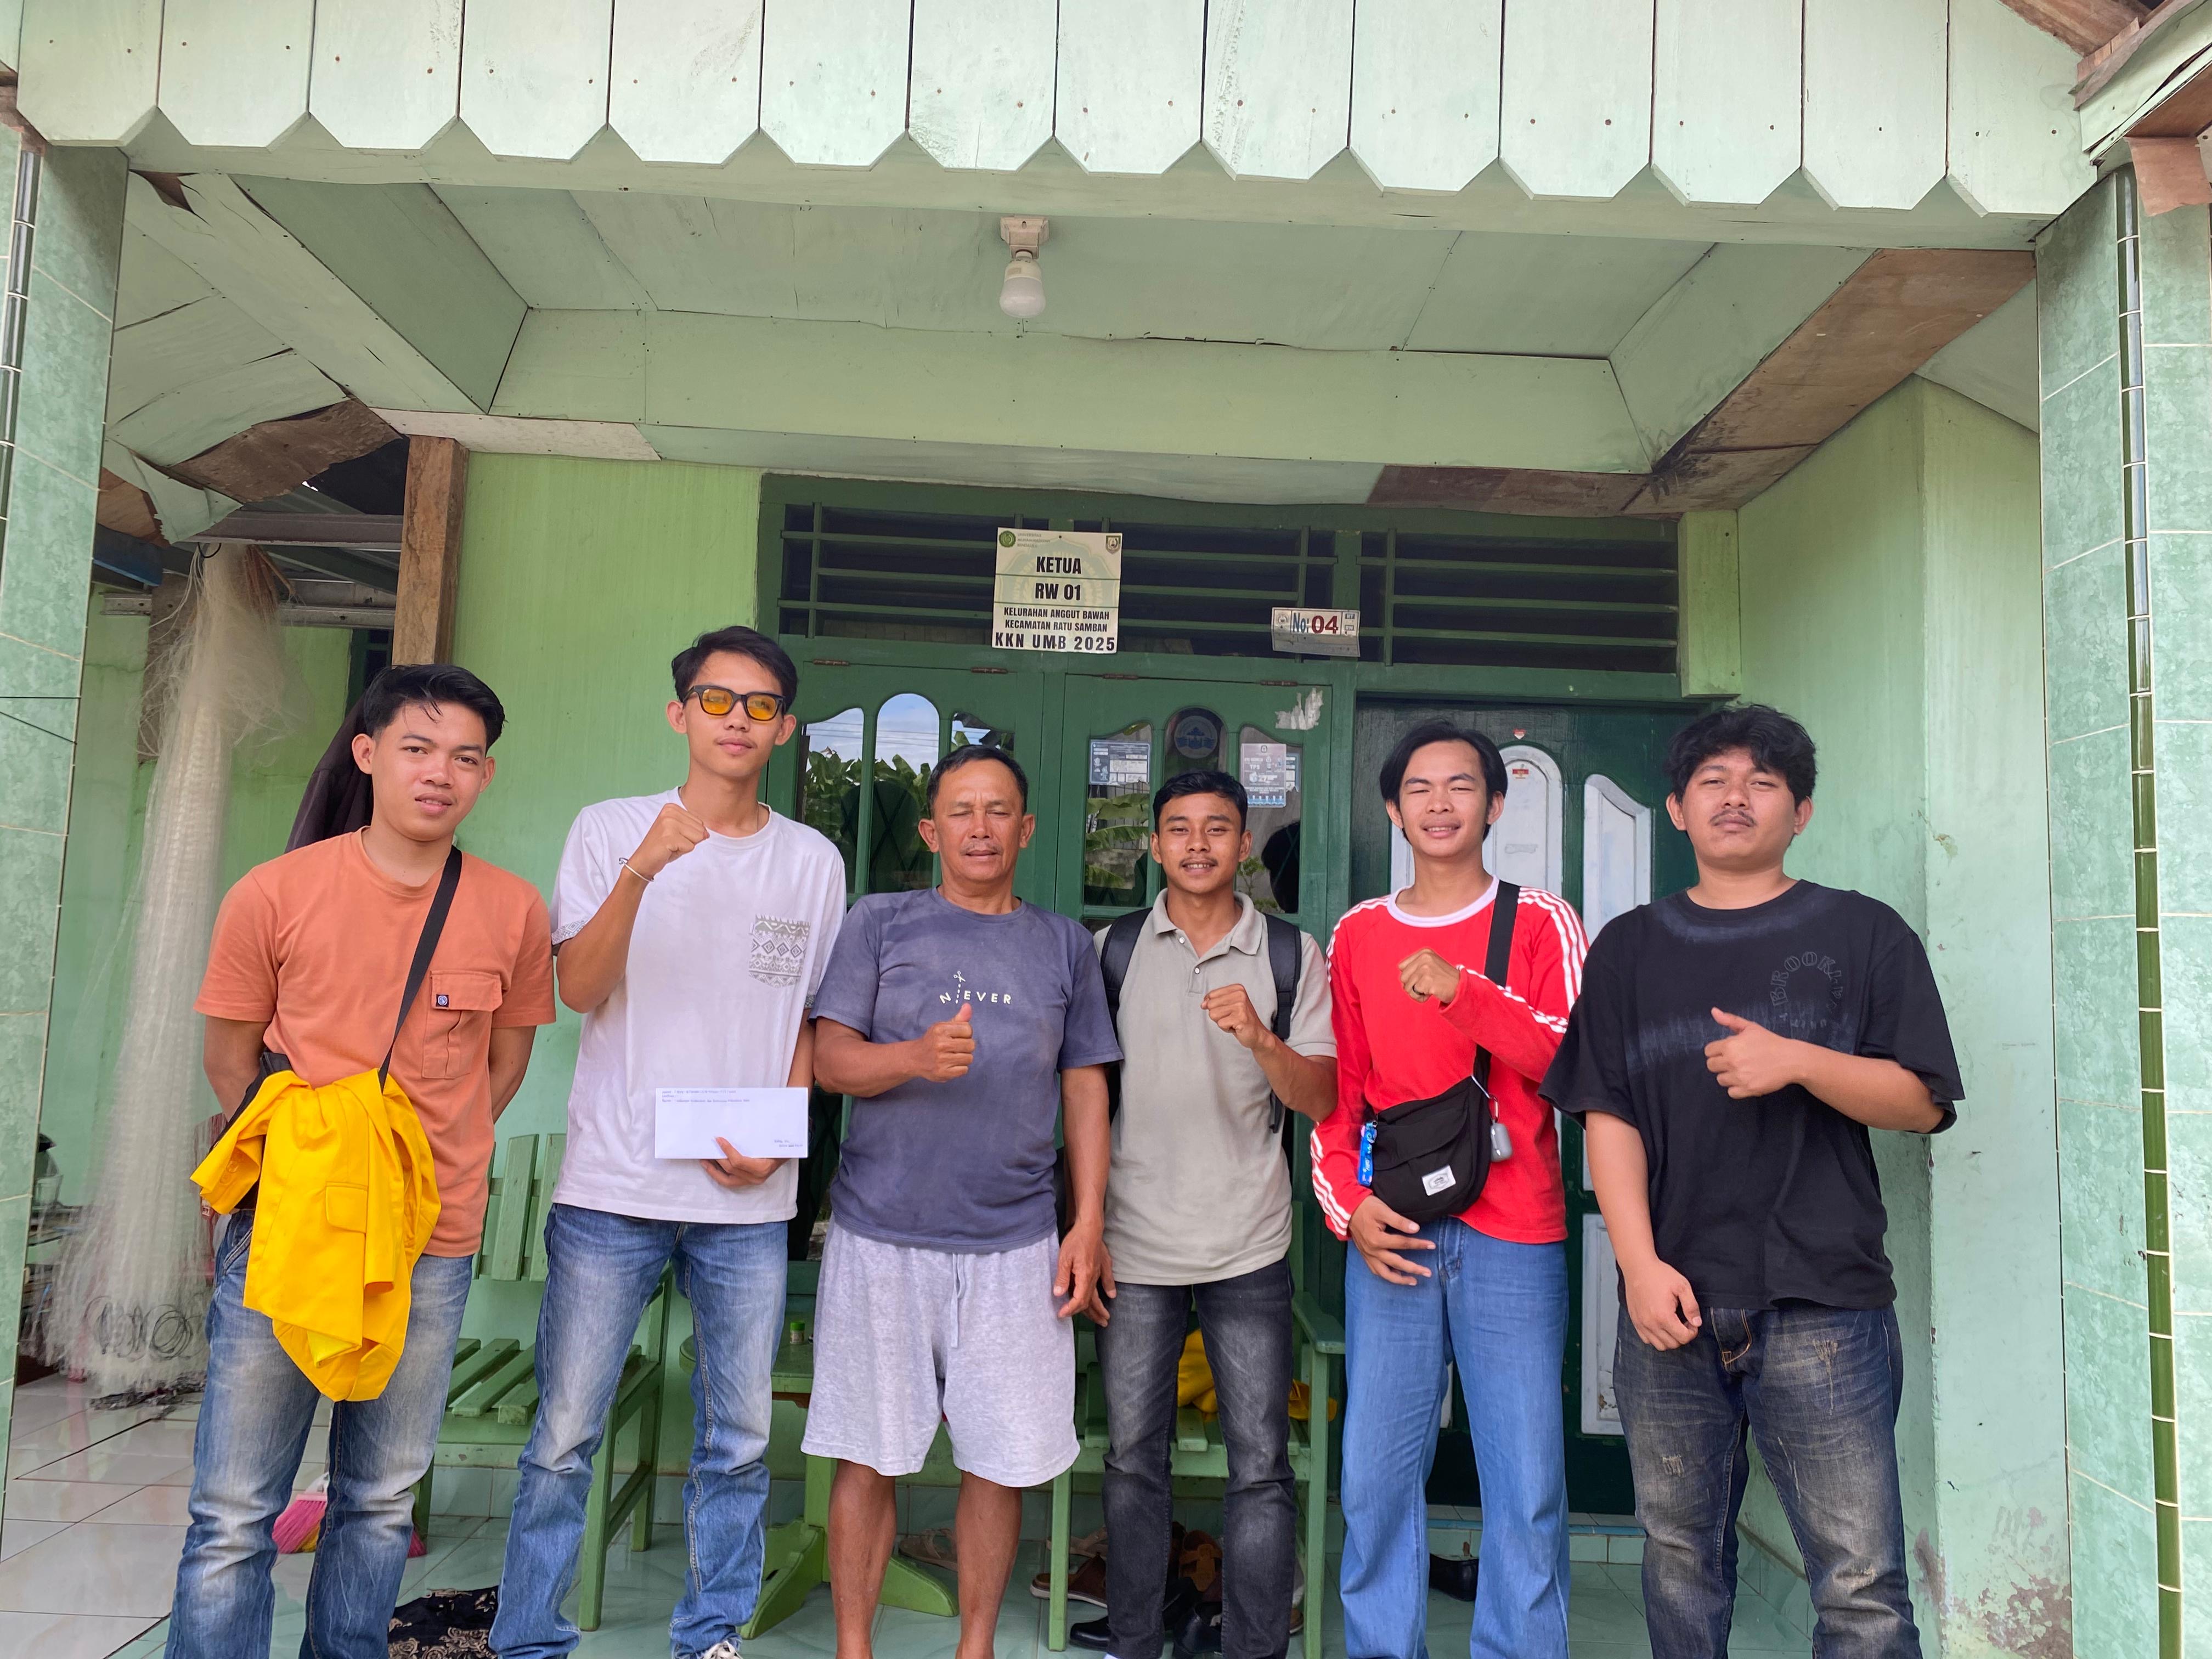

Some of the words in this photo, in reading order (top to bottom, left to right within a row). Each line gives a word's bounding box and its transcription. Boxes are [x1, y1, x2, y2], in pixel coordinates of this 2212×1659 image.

[1036, 556, 1081, 574] KETUA
[1035, 583, 1059, 600] RW
[1064, 584, 1081, 601] 01
[1004, 607, 1048, 618] KELURAHAN
[1050, 609, 1080, 619] ANGGUT
[1082, 610, 1109, 620] BAWAH
[1005, 619, 1051, 630] KECAMATAN
[1053, 622, 1072, 631] RATU
[1075, 623, 1107, 632] SAMBAN
[1311, 615, 1339, 634] 04
[995, 632, 1024, 648] KKN
[1032, 634, 1066, 649] UMB
[1074, 636, 1115, 651] 2025
